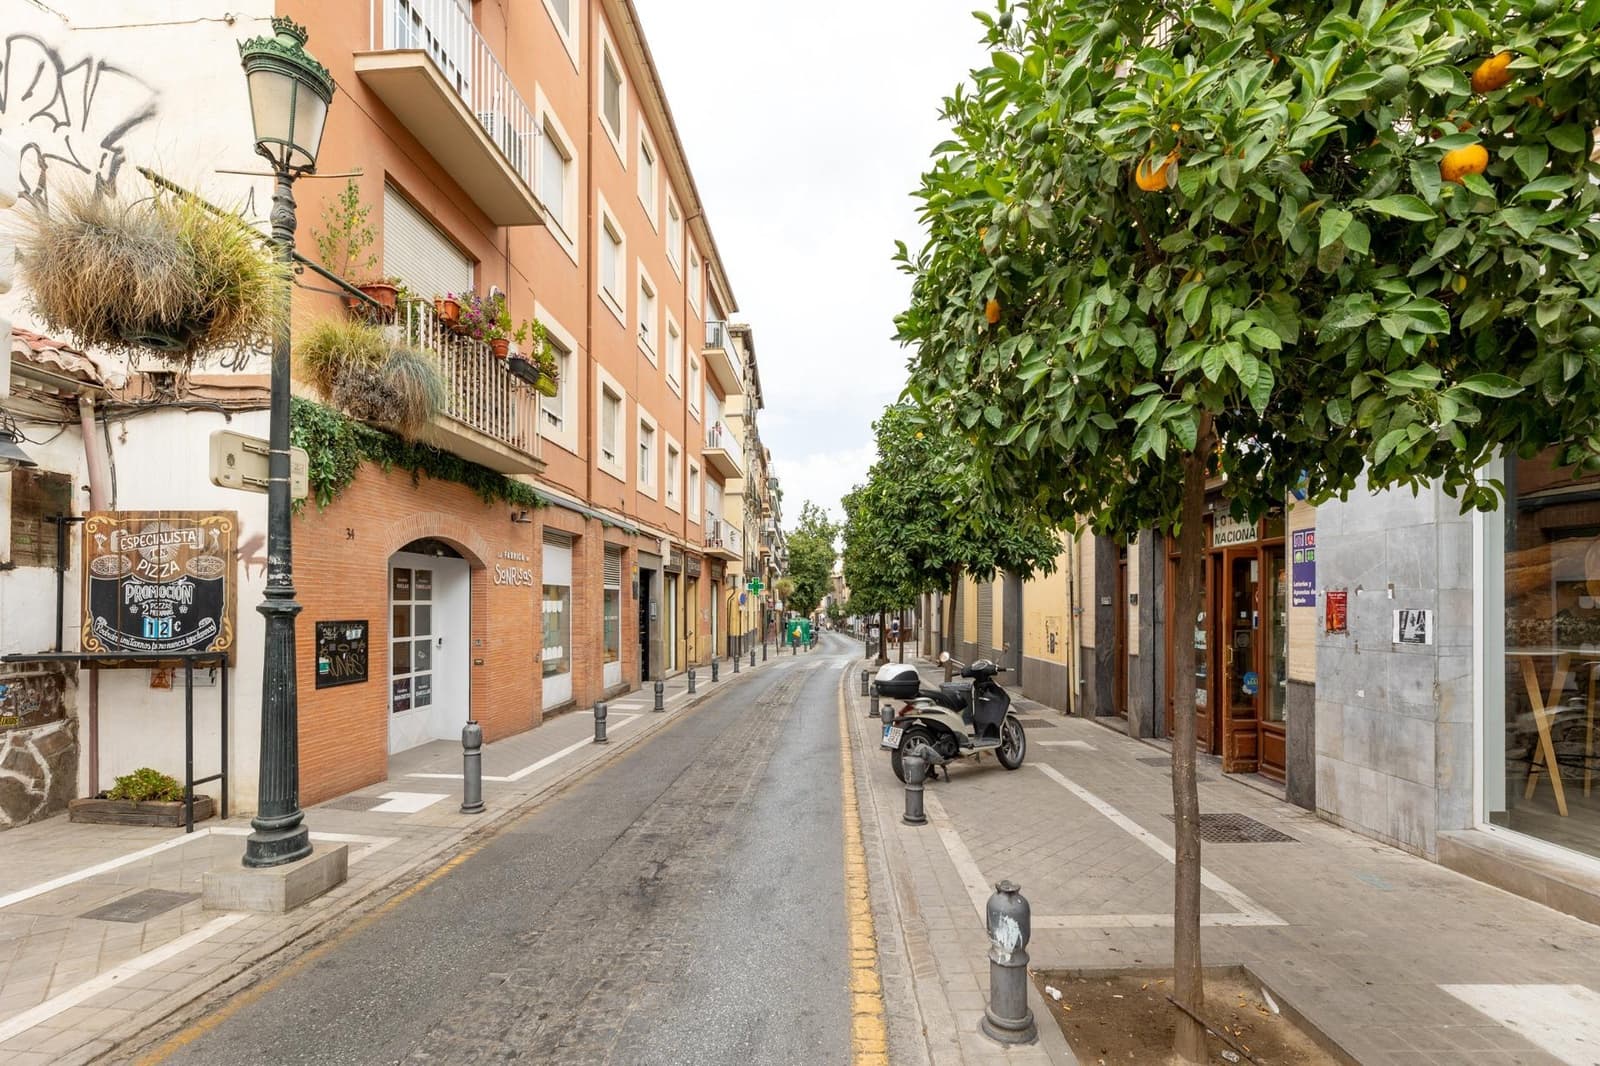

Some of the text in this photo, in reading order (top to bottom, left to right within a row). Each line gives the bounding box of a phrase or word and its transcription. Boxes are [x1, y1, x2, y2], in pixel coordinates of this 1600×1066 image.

[120, 530, 196, 550] ESPECIALISTA
[1214, 527, 1257, 545] NACIONA
[135, 558, 180, 578] PIZZA
[142, 603, 149, 615] 2
[147, 620, 182, 636] 12 €
